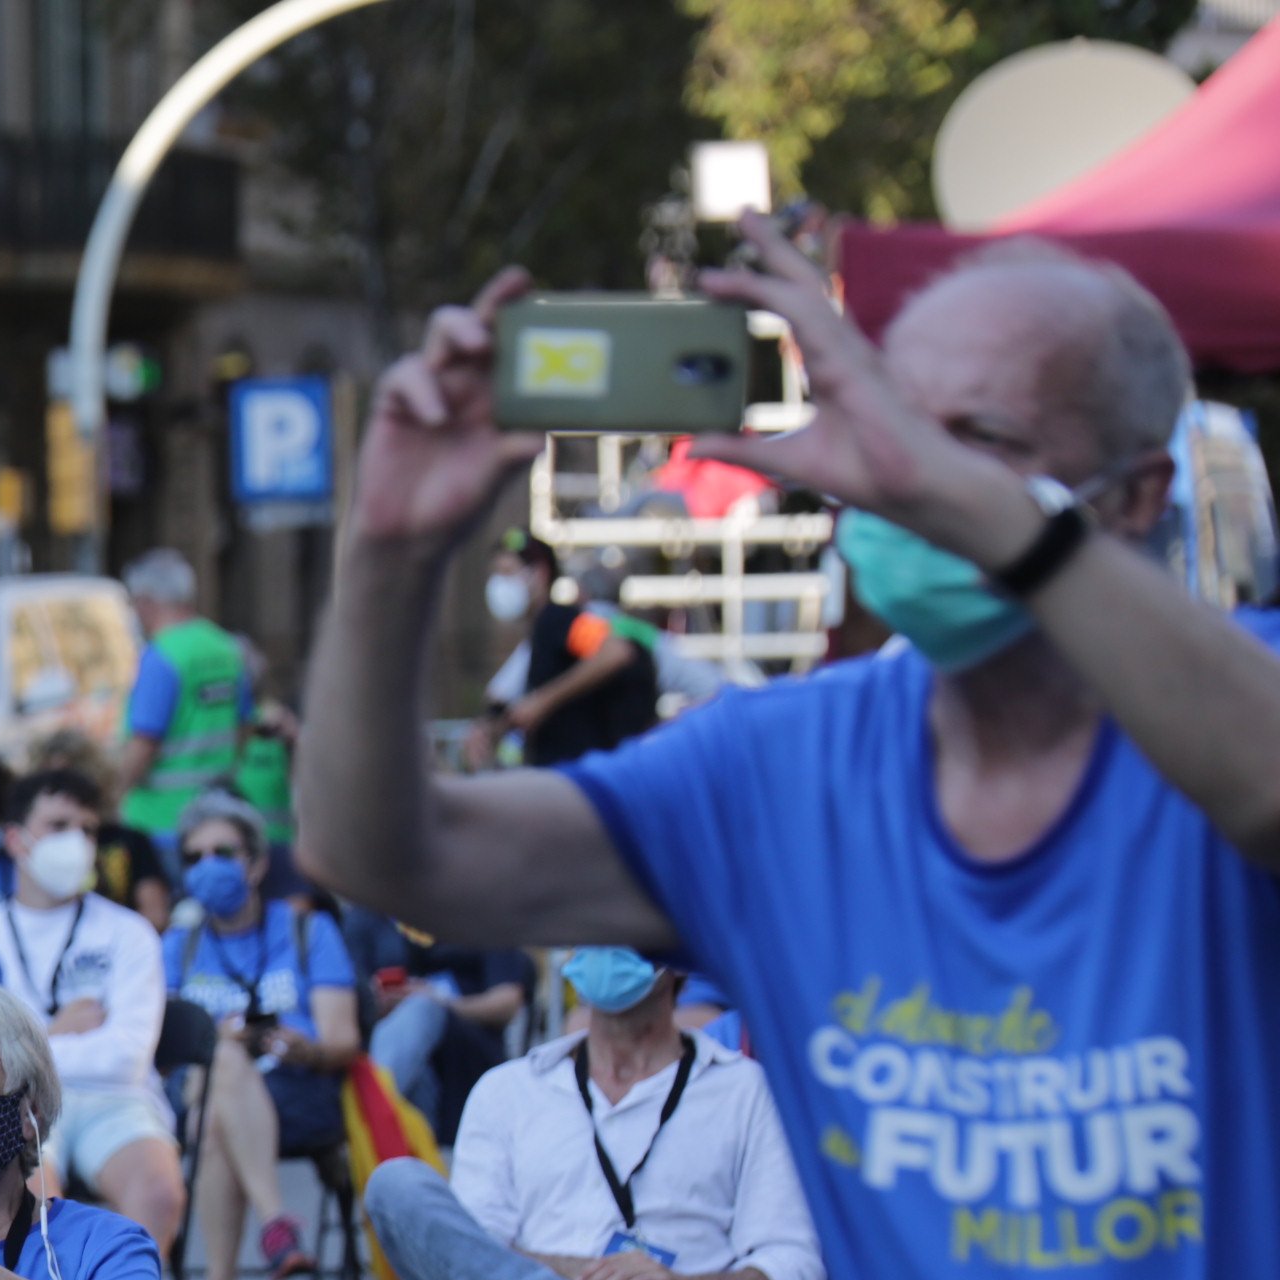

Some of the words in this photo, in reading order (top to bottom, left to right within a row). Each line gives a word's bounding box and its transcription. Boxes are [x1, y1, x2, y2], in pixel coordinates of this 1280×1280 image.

[243, 388, 320, 492] P
[809, 1025, 1192, 1118] CONSTRUIR
[862, 1100, 1202, 1207] FUTUR
[950, 1189, 1205, 1268] MILLOR
